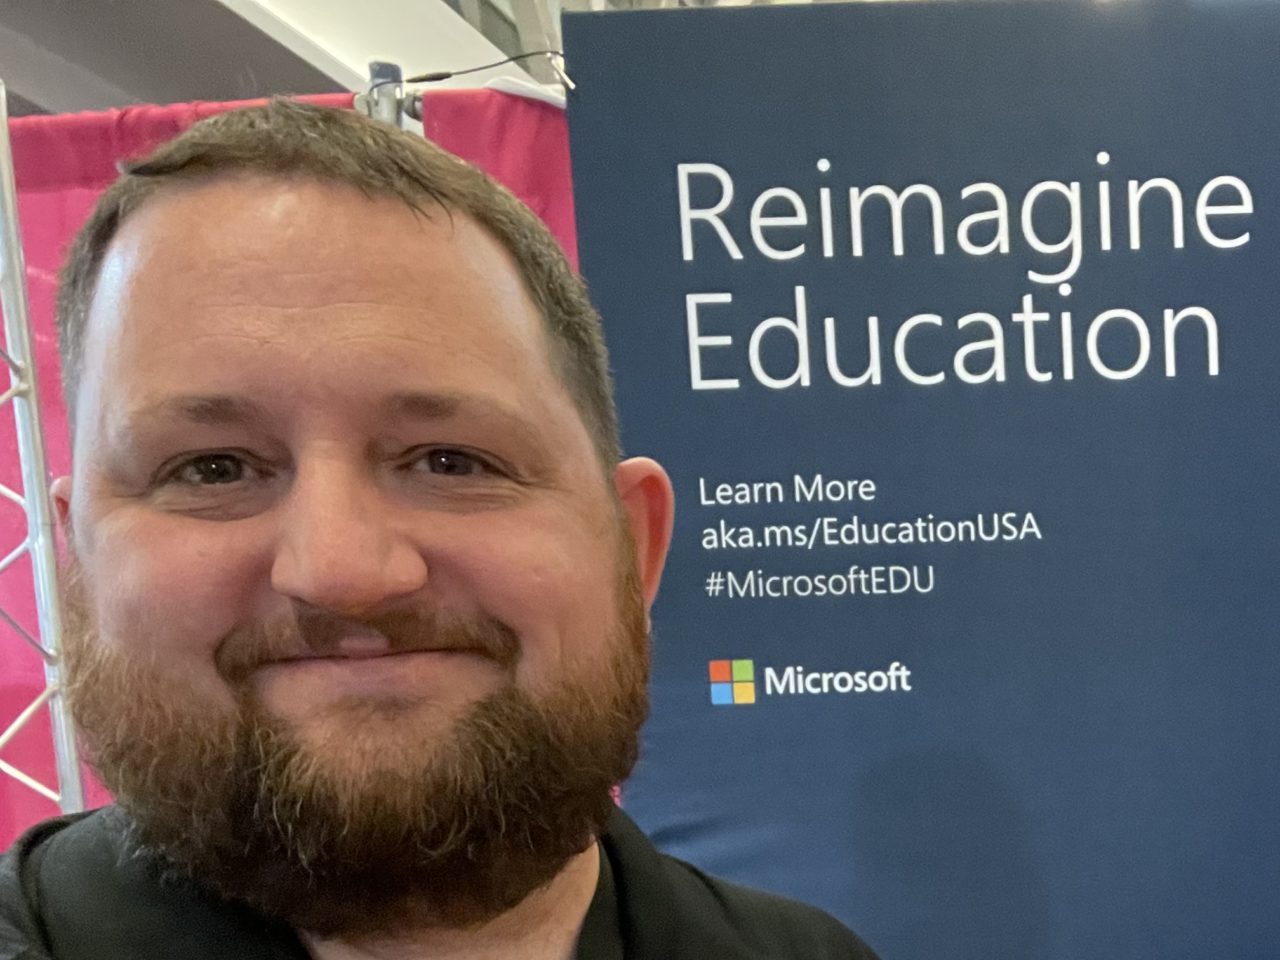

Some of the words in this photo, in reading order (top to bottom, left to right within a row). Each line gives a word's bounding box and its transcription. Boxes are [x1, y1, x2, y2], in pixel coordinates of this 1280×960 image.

[677, 152, 1253, 282] Reimagine
[686, 285, 1219, 390] Education
[700, 478, 783, 505] Learn
[794, 474, 876, 502] More
[702, 512, 1042, 549] aka.ms/EducationUSA
[706, 565, 934, 598] #MicrosoftEDU
[765, 662, 912, 695] Microsoft
